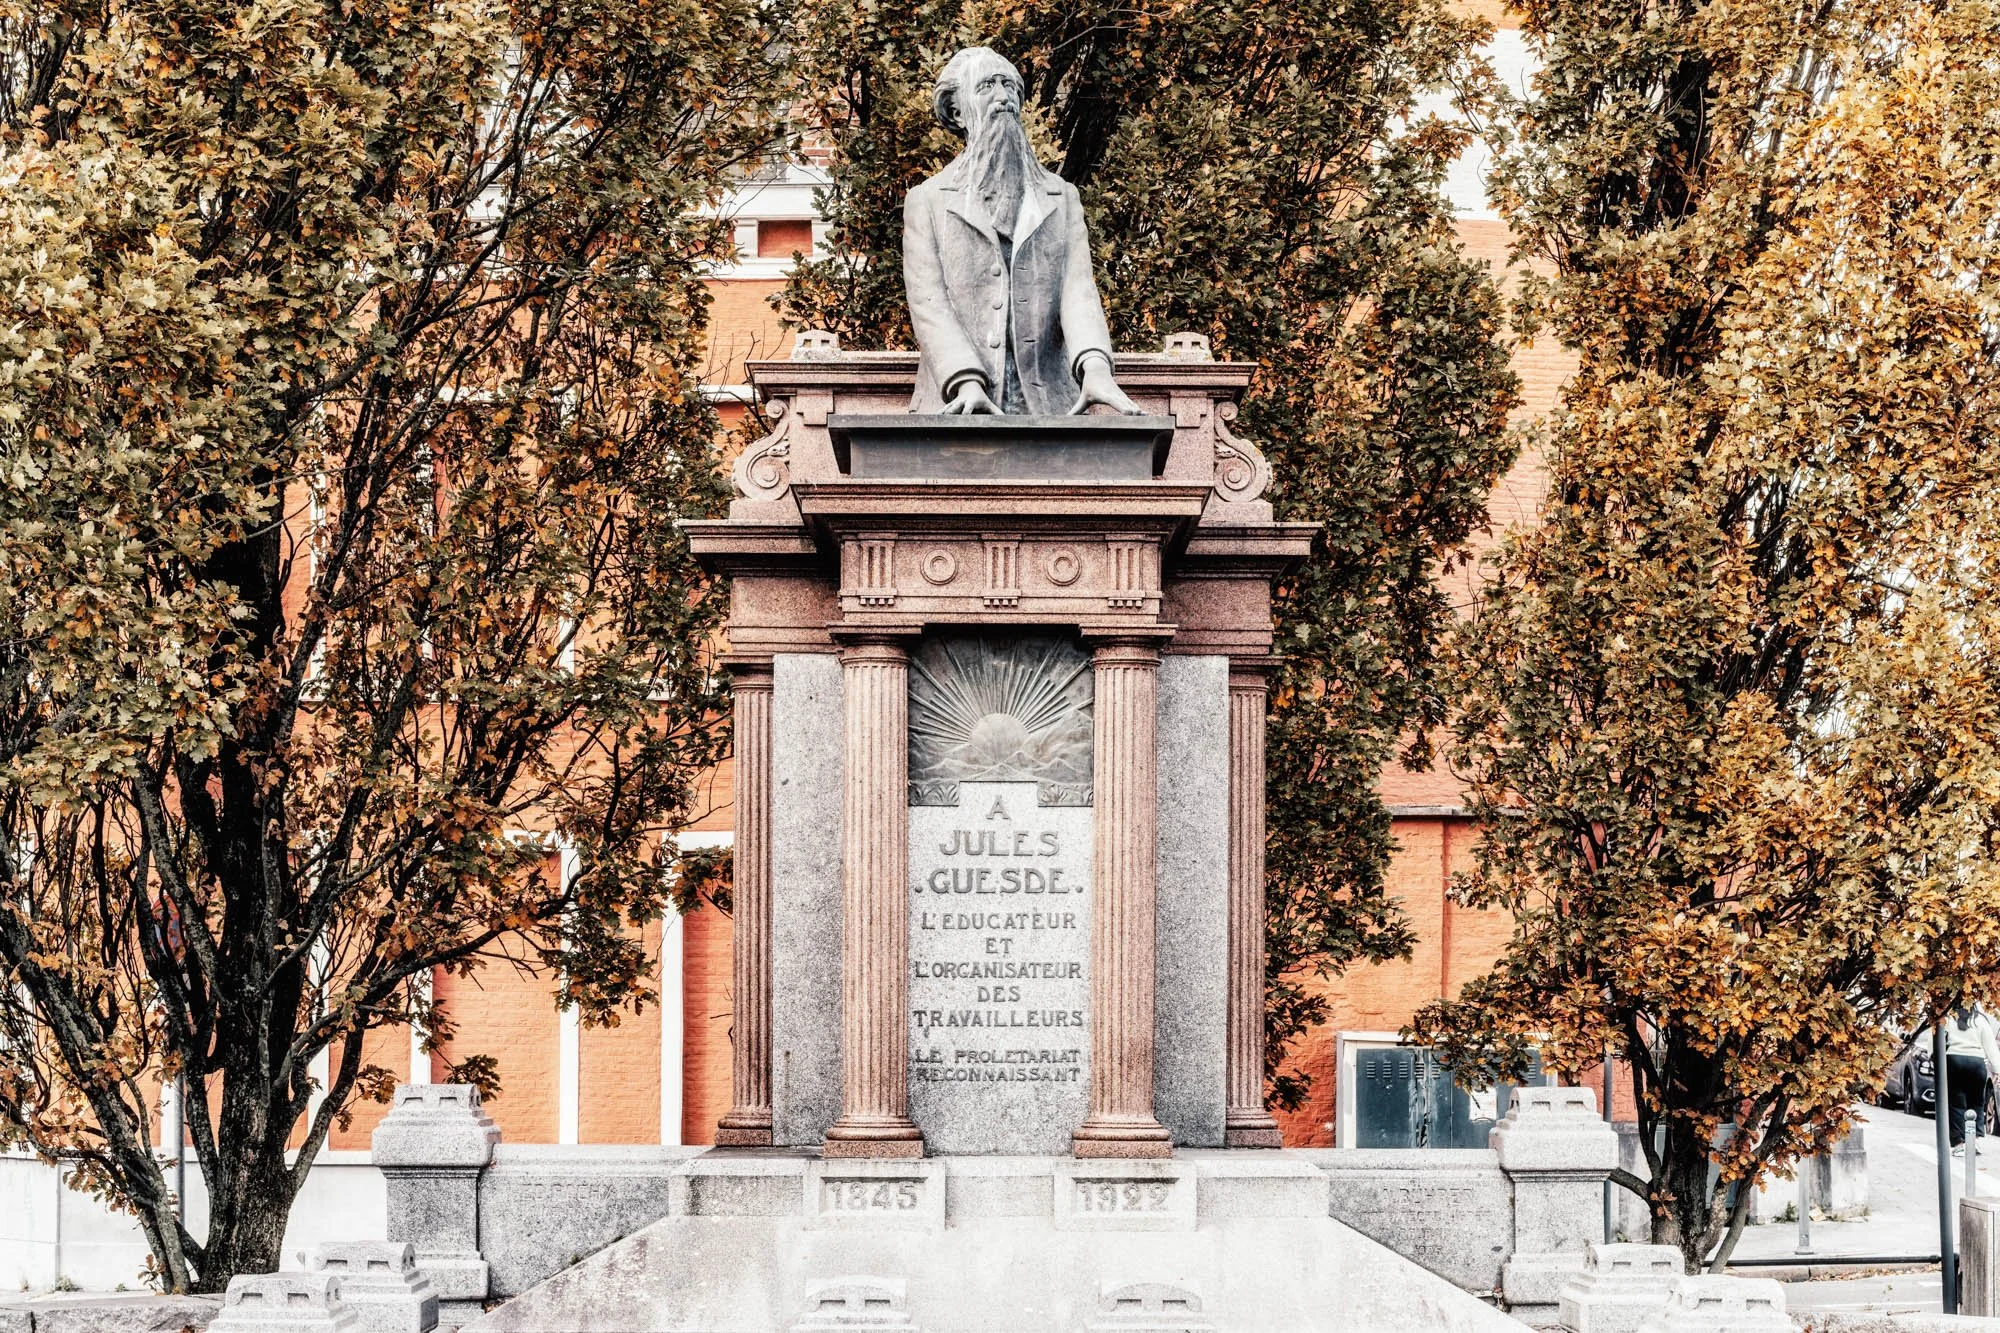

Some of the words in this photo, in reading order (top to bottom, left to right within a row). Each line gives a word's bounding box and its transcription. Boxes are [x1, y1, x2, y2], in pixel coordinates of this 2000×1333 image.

[985, 795, 1011, 820] A
[939, 829, 1060, 857] JULES
[921, 912, 1077, 930] L'EDUCATEUR
[985, 937, 1014, 954] ET
[915, 961, 1082, 979] L'ORGANISATEUR
[977, 985, 1021, 1003] DES
[913, 1010, 1083, 1028] TRAVAILLEURS
[915, 1049, 943, 1064] LE
[954, 1049, 1081, 1064] PROLETARIAT
[915, 1067, 1081, 1082] RECONNAISSANT
[829, 1180, 919, 1211] 1845
[1078, 1181, 1170, 1212] 1922
